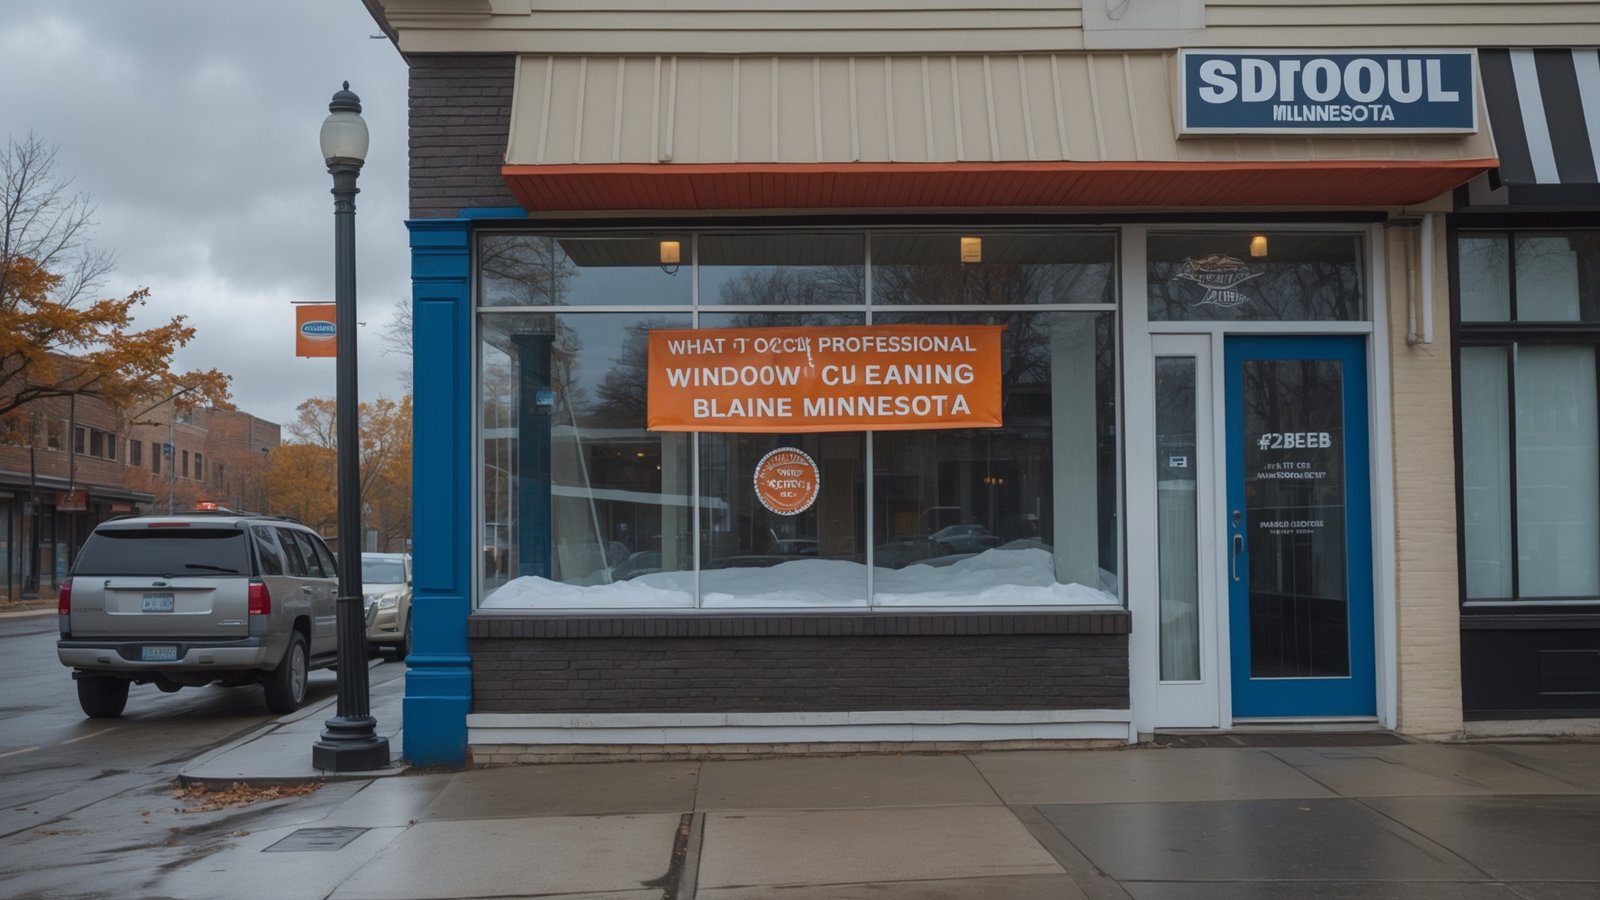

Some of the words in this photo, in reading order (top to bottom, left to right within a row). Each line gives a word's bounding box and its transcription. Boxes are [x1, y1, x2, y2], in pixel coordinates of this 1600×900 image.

[668, 339, 725, 355] WHAT
[818, 336, 977, 353] PROFESSIONAL
[666, 366, 800, 388] WINDOOW
[694, 397, 793, 418] BLAINE
[804, 395, 970, 417] MINNESOTA
